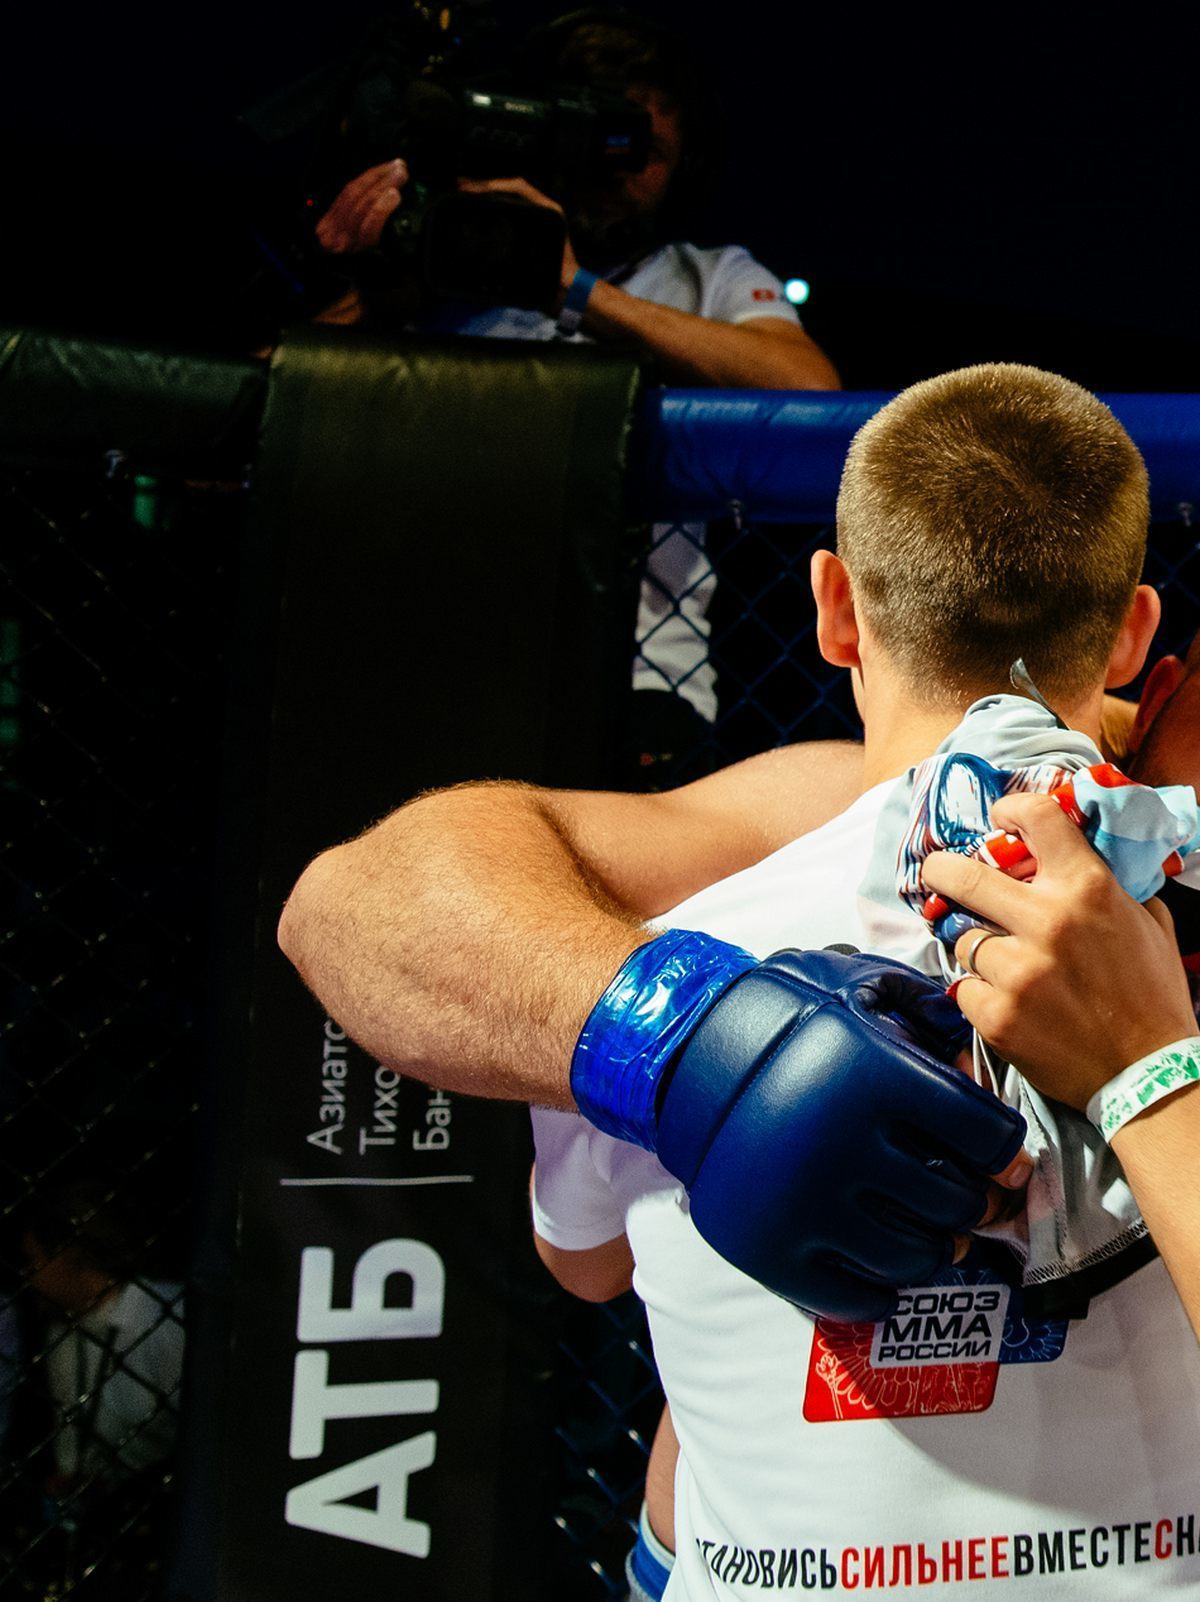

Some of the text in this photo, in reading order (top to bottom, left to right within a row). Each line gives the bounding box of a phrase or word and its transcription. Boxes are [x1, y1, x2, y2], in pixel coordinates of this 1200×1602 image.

[358, 1065, 401, 1156] Тихо
[896, 1291, 1000, 1316] СОЮЗ
[881, 1313, 992, 1343] ММА
[878, 1340, 991, 1362] РОССИИ
[284, 1237, 447, 1560] АТБ
